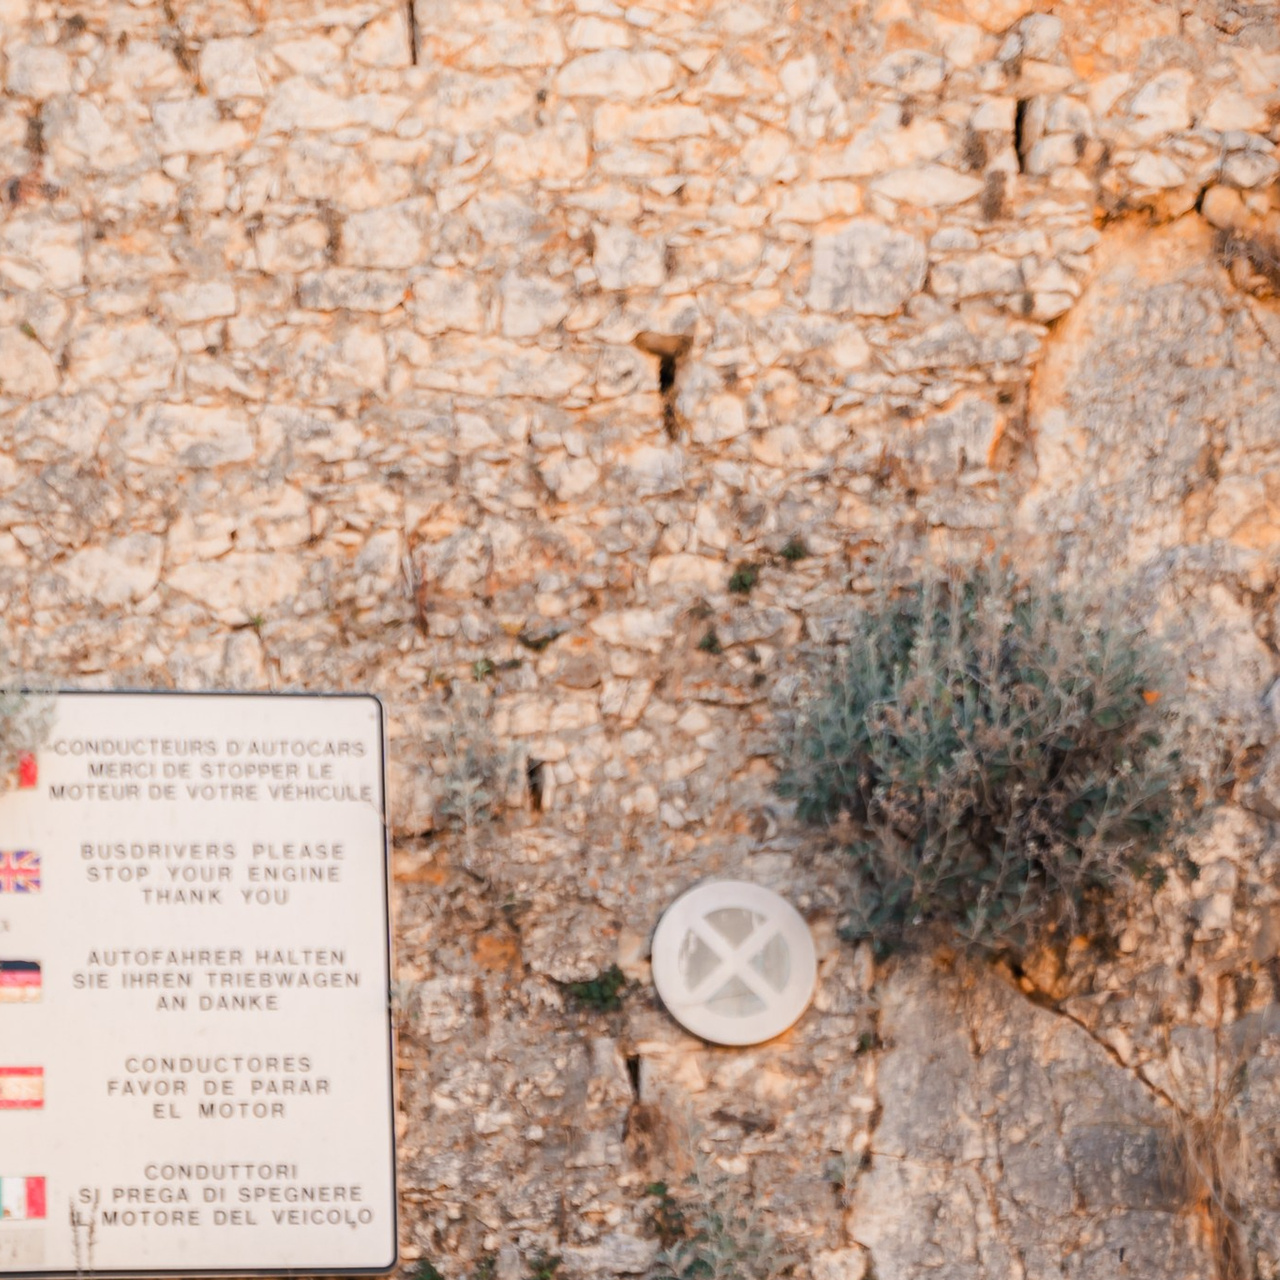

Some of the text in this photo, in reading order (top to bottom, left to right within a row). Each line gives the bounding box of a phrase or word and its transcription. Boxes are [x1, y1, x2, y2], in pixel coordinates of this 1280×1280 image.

[54, 739, 366, 758] CONDUCTEURS D'AUTOCARS
[88, 762, 333, 779] MERCI DE STOPPER LE
[49, 785, 139, 801] MOTEUR
[148, 785, 176, 801] DE
[186, 785, 259, 801] VOTRE
[80, 843, 345, 860] BUSDRIVERS PLEASE
[86, 866, 341, 882] STOP YOUR ENGINE
[142, 888, 291, 905] THANK YOU
[87, 949, 346, 966] AUTOFAHRER HALTEN
[73, 972, 360, 989] SIE IHREN TRIEBWAGEN
[156, 995, 279, 1012] AN DANKE
[125, 1057, 311, 1073] CONDUCTORES
[107, 1079, 331, 1096] FAVOR DE PARAR
[153, 1102, 285, 1119] EL MOTOR
[144, 1164, 298, 1180] CONDUTTORI
[79, 1186, 363, 1204] SI PREGA DI SPEGNERE
[102, 1210, 200, 1227] MOTORE
[214, 1210, 257, 1227] DEL
[272, 1208, 373, 1227] VEICOLO
